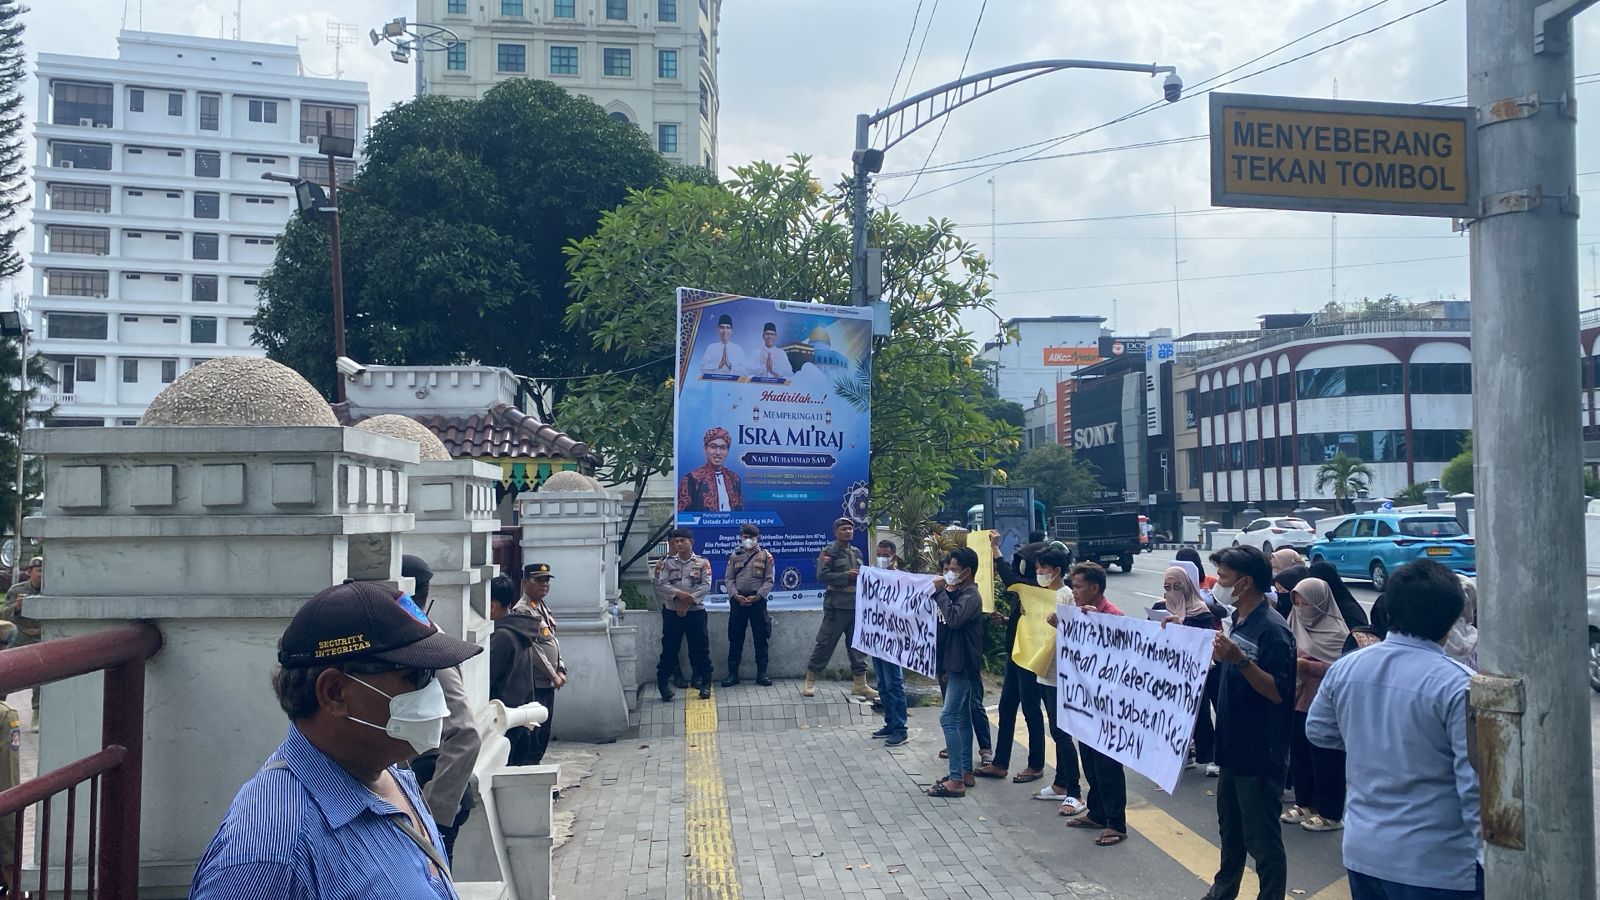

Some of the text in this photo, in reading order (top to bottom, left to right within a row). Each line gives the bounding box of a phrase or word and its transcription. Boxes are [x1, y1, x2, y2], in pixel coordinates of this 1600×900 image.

[1233, 120, 1453, 158] MENYEBERANG
[1231, 154, 1456, 192] TEKAN TOMBOL
[1158, 350, 1174, 359] ap
[763, 410, 823, 421] MEMPERINGATI
[739, 425, 781, 446] ISRA
[1074, 422, 1118, 449] SONY
[752, 455, 769, 463] NABI
[770, 455, 811, 464] MUHAMMAD
[315, 641, 371, 658] INTEGRITAS
[318, 634, 364, 649] SECURITY
[1098, 653, 1119, 684] dan
[1093, 684, 1114, 717] dari
[1097, 718, 1145, 760] MEDAN
